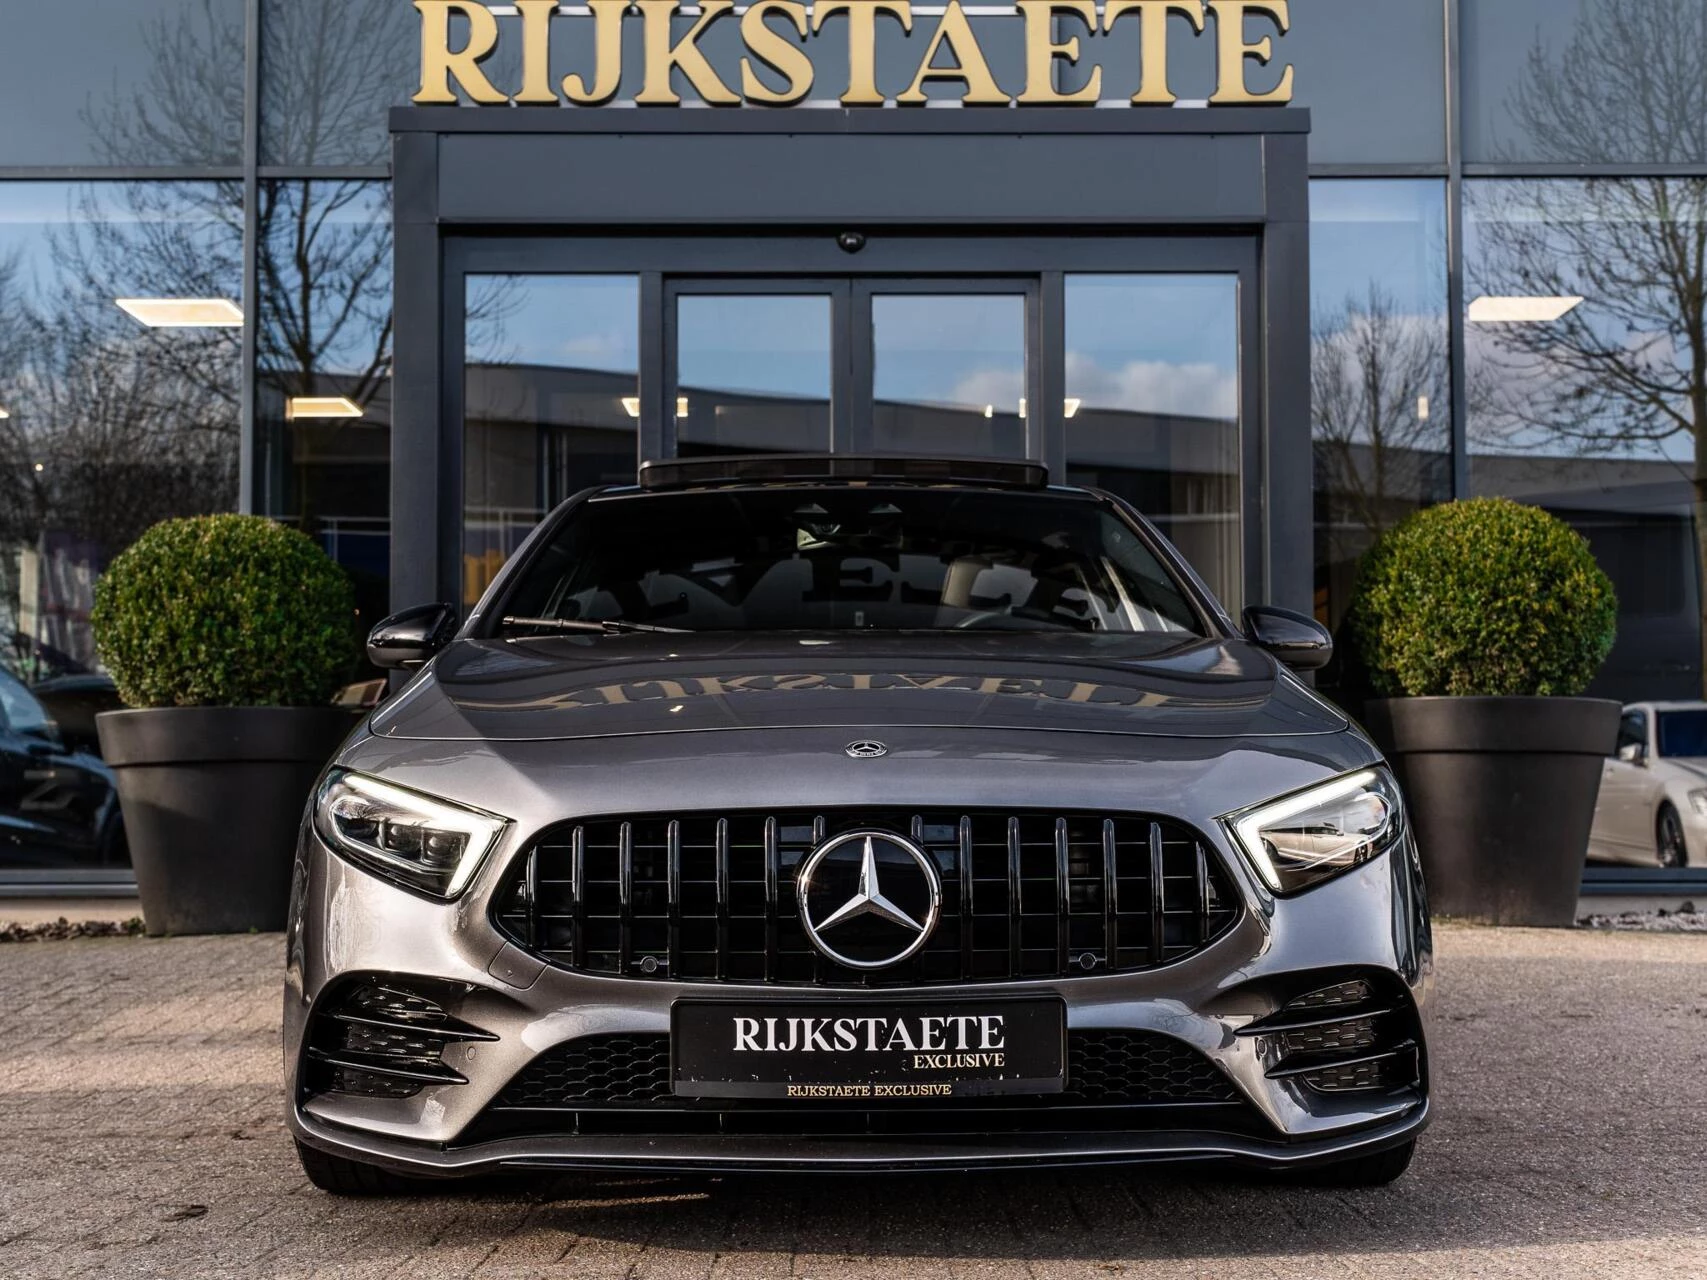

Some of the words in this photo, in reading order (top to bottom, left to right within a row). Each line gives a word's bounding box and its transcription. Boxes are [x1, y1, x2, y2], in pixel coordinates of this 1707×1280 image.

[412, 0, 1294, 105] RIJKSTAETE
[733, 1015, 1005, 1052] RIJKSTAETE
[913, 1052, 1005, 1069] EXCLUSIVE
[786, 1084, 871, 1097] RIJKSTAETE
[874, 1083, 952, 1097] EXCLUSIVE
